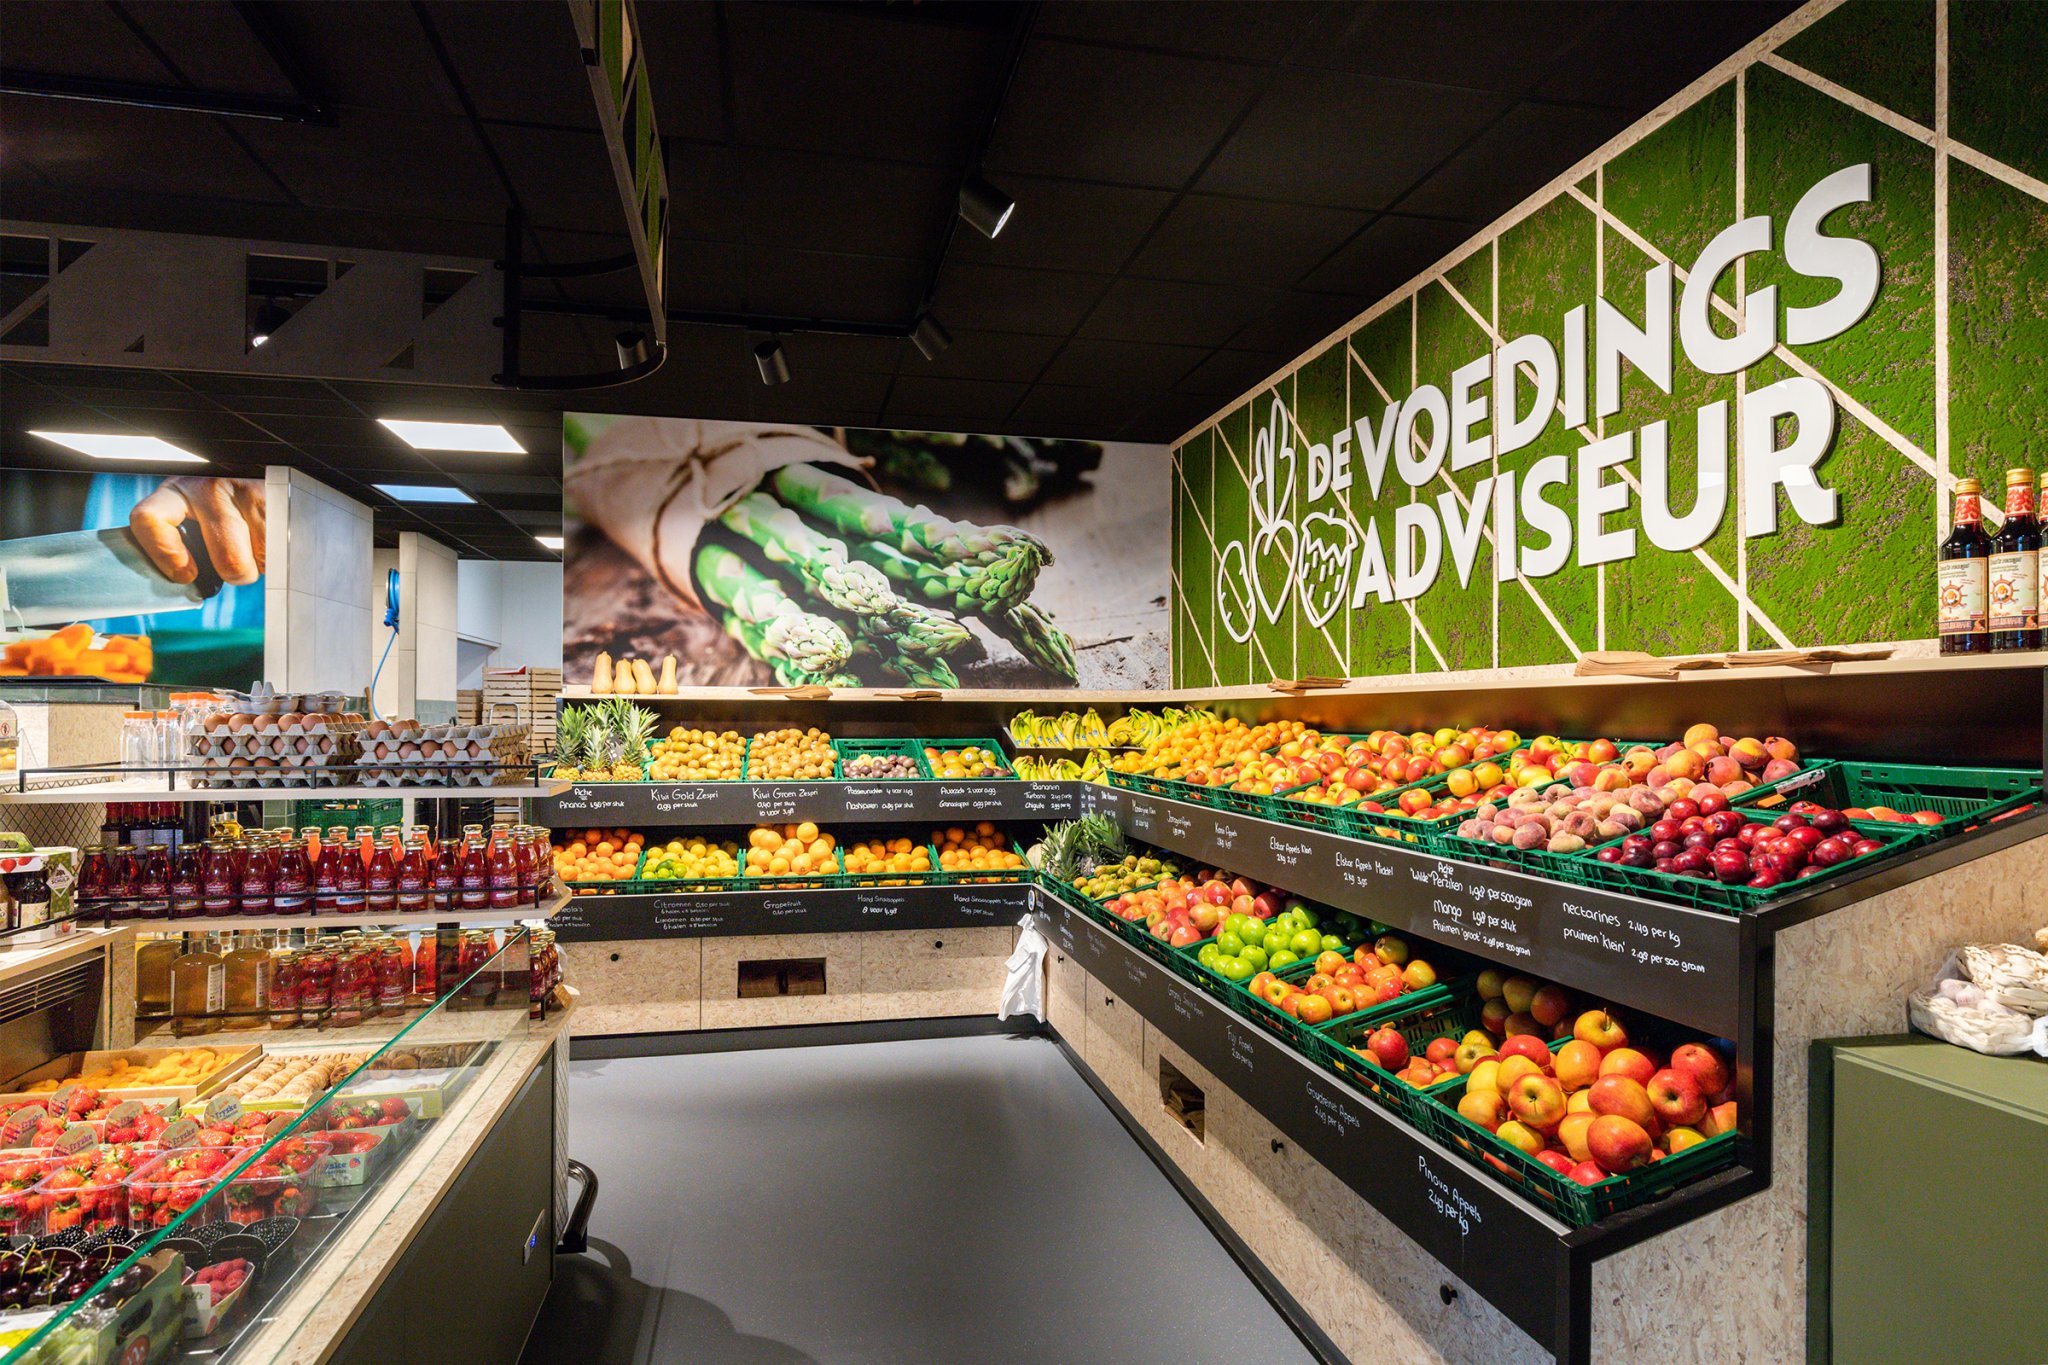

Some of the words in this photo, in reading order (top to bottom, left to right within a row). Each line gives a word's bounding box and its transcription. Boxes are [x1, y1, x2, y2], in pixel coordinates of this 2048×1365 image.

[1306, 425, 1352, 503] DE
[1354, 162, 1881, 502] VOEDINGS
[1351, 376, 1838, 610] ADVISEUR
[650, 788, 670, 801] Kiwi
[672, 788, 694, 800] Gold
[696, 788, 718, 800] Zespri
[752, 787, 770, 799] Kiwi
[773, 787, 796, 799] Groen
[798, 788, 818, 798] Zespri
[1336, 852, 1352, 867] Elstar
[1355, 858, 1372, 872] Appels
[654, 899, 692, 908] Citroenen
[763, 900, 802, 910] Grapefruit
[858, 894, 874, 902] Hand
[1488, 888, 1500, 900] per
[1500, 892, 1515, 904] 500
[1514, 896, 1532, 910] gram
[1434, 900, 1462, 921] Mango
[1488, 915, 1500, 928] per
[1500, 918, 1517, 933] stuk
[1562, 902, 1620, 927] nectarines
[1651, 927, 1666, 938] per
[1669, 930, 1680, 948] kg
[1432, 920, 1460, 936] Pruimen
[1496, 940, 1504, 949] per
[1515, 947, 1531, 956] gram
[1563, 927, 1599, 944] pruimen
[1650, 955, 1664, 965] per
[1664, 956, 1680, 967] 500
[1681, 960, 1706, 974] gram
[1328, 1116, 1337, 1128] per
[1337, 1122, 1345, 1136] kg
[1339, 1104, 1360, 1128] Appels
[1418, 1155, 1449, 1196] Pinova
[1452, 1188, 1482, 1223] Appels
[1445, 1202, 1458, 1218] per
[1458, 1209, 1469, 1236] kg
